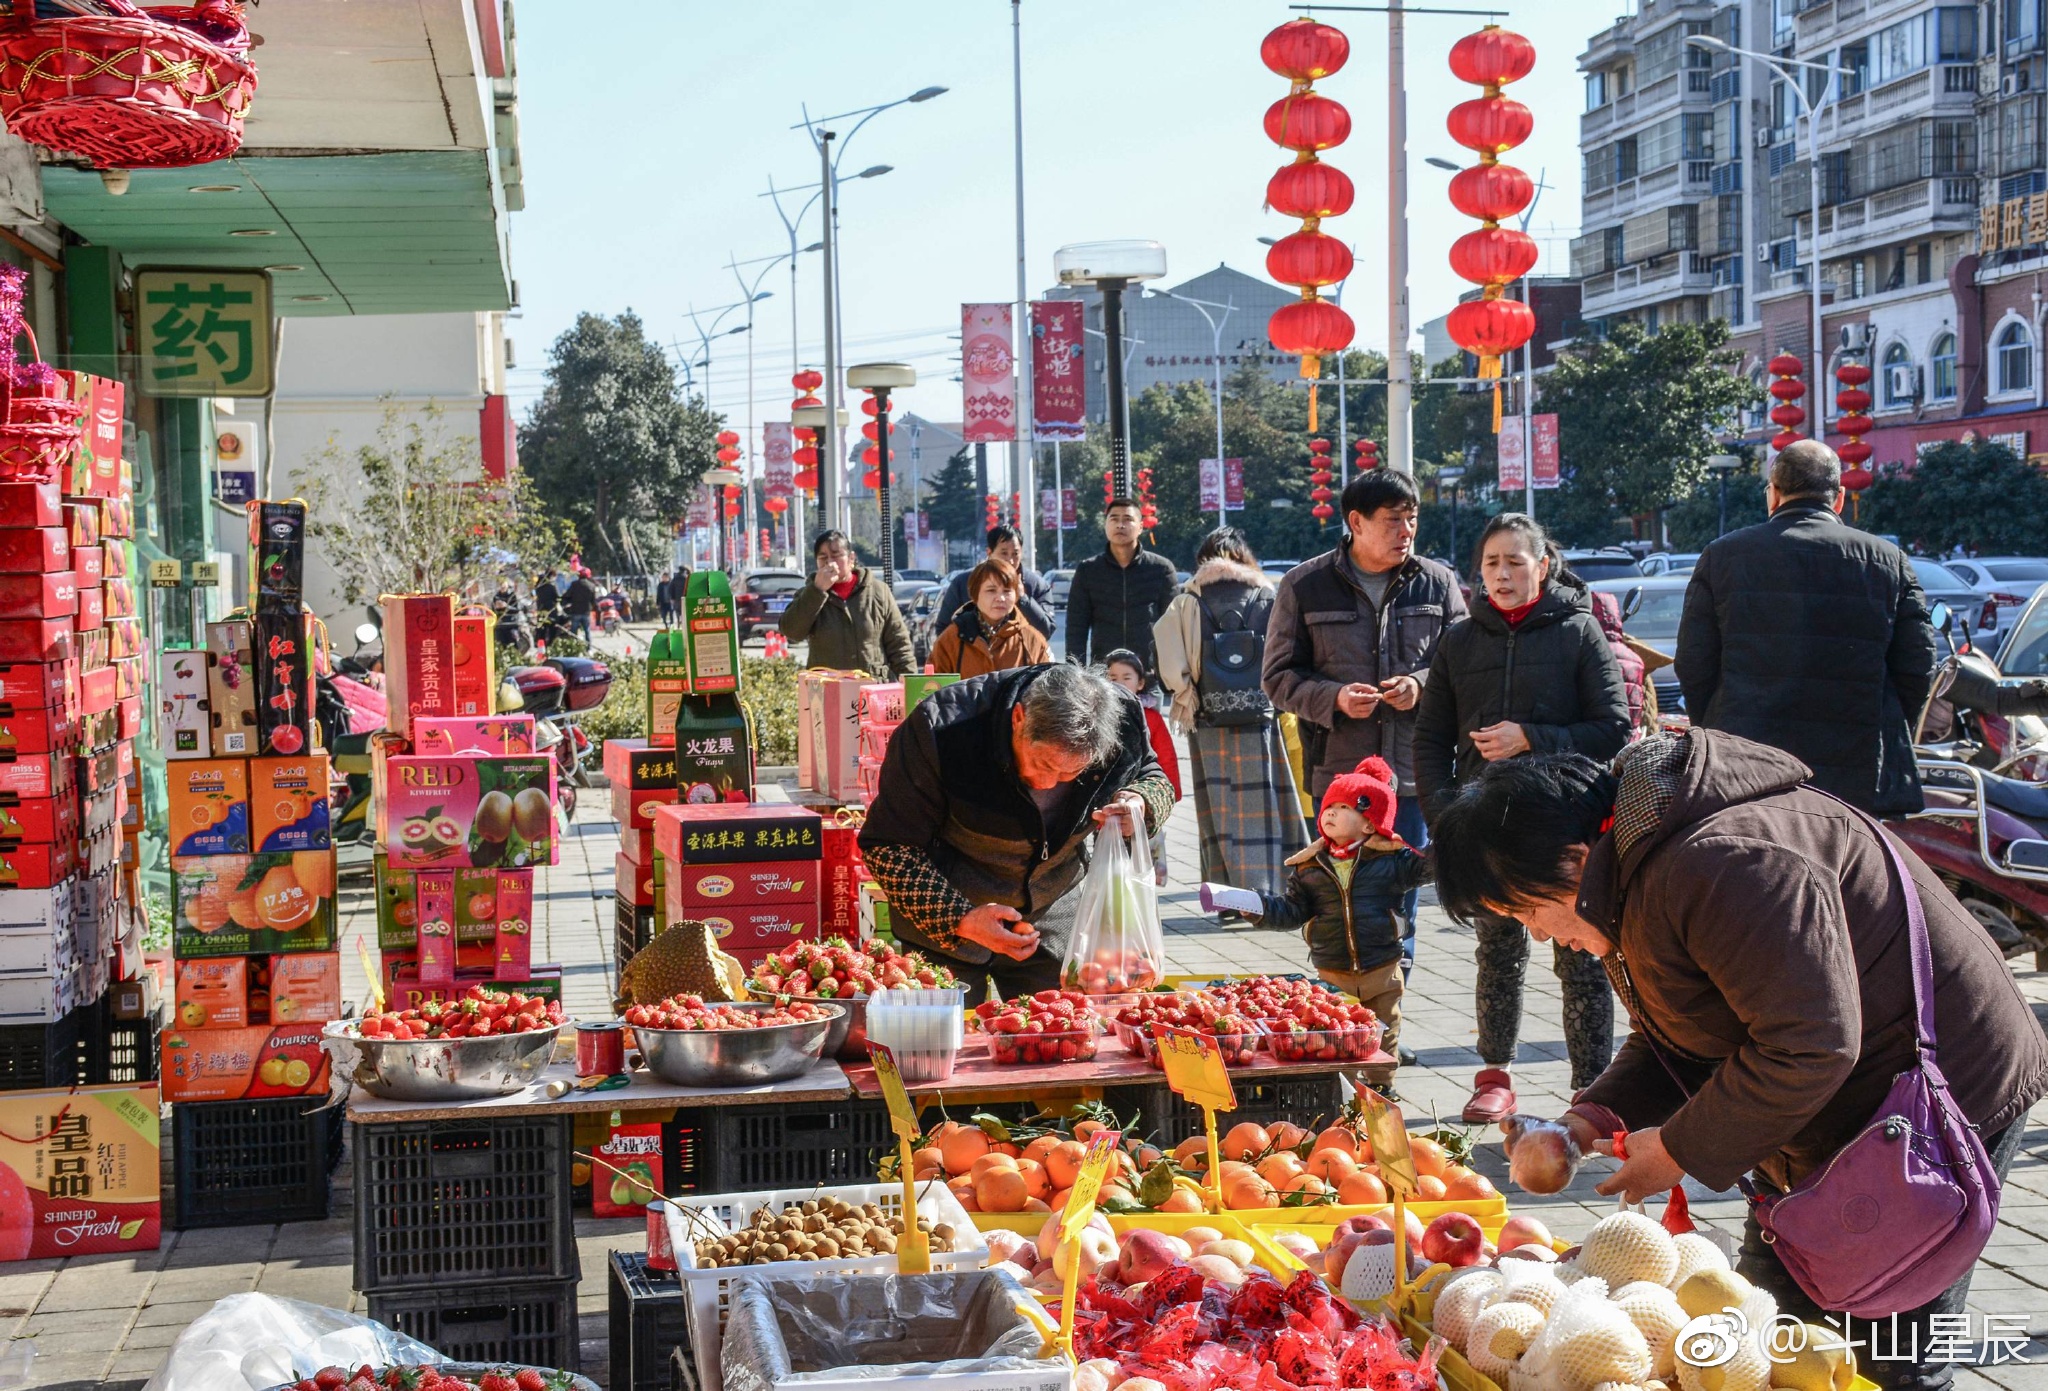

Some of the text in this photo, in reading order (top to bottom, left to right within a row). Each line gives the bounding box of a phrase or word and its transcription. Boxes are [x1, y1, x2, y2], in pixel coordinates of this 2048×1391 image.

[147, 282, 253, 385] 药
[158, 563, 175, 578] 拉
[198, 564, 213, 578] 推
[156, 580, 176, 588] PULL
[420, 638, 441, 709] 皇家贡品
[686, 737, 735, 755] 火龙果
[11, 764, 32, 773] miss
[695, 757, 724, 768] Pitaya
[397, 765, 465, 787] RED
[409, 789, 451, 797] KIWIFRUIT
[687, 828, 816, 850] 圣源苹果 果真出色
[501, 878, 531, 889] RED
[750, 873, 779, 881] SHINEHO
[421, 880, 451, 891] RED
[756, 876, 792, 895] Fresh
[832, 865, 850, 927] 皇家贡品
[750, 915, 779, 923] SHINEHO
[755, 918, 792, 937] Fresh
[205, 934, 249, 944] ORANGE
[270, 1034, 320, 1049] Oranges
[119, 1098, 149, 1124] 新包装
[48, 1113, 93, 1199] 皇品
[97, 1142, 114, 1190] 红富士
[118, 1162, 127, 1190] APPLE
[44, 1209, 97, 1223] SHINEHO
[55, 1215, 120, 1246] Fresh
